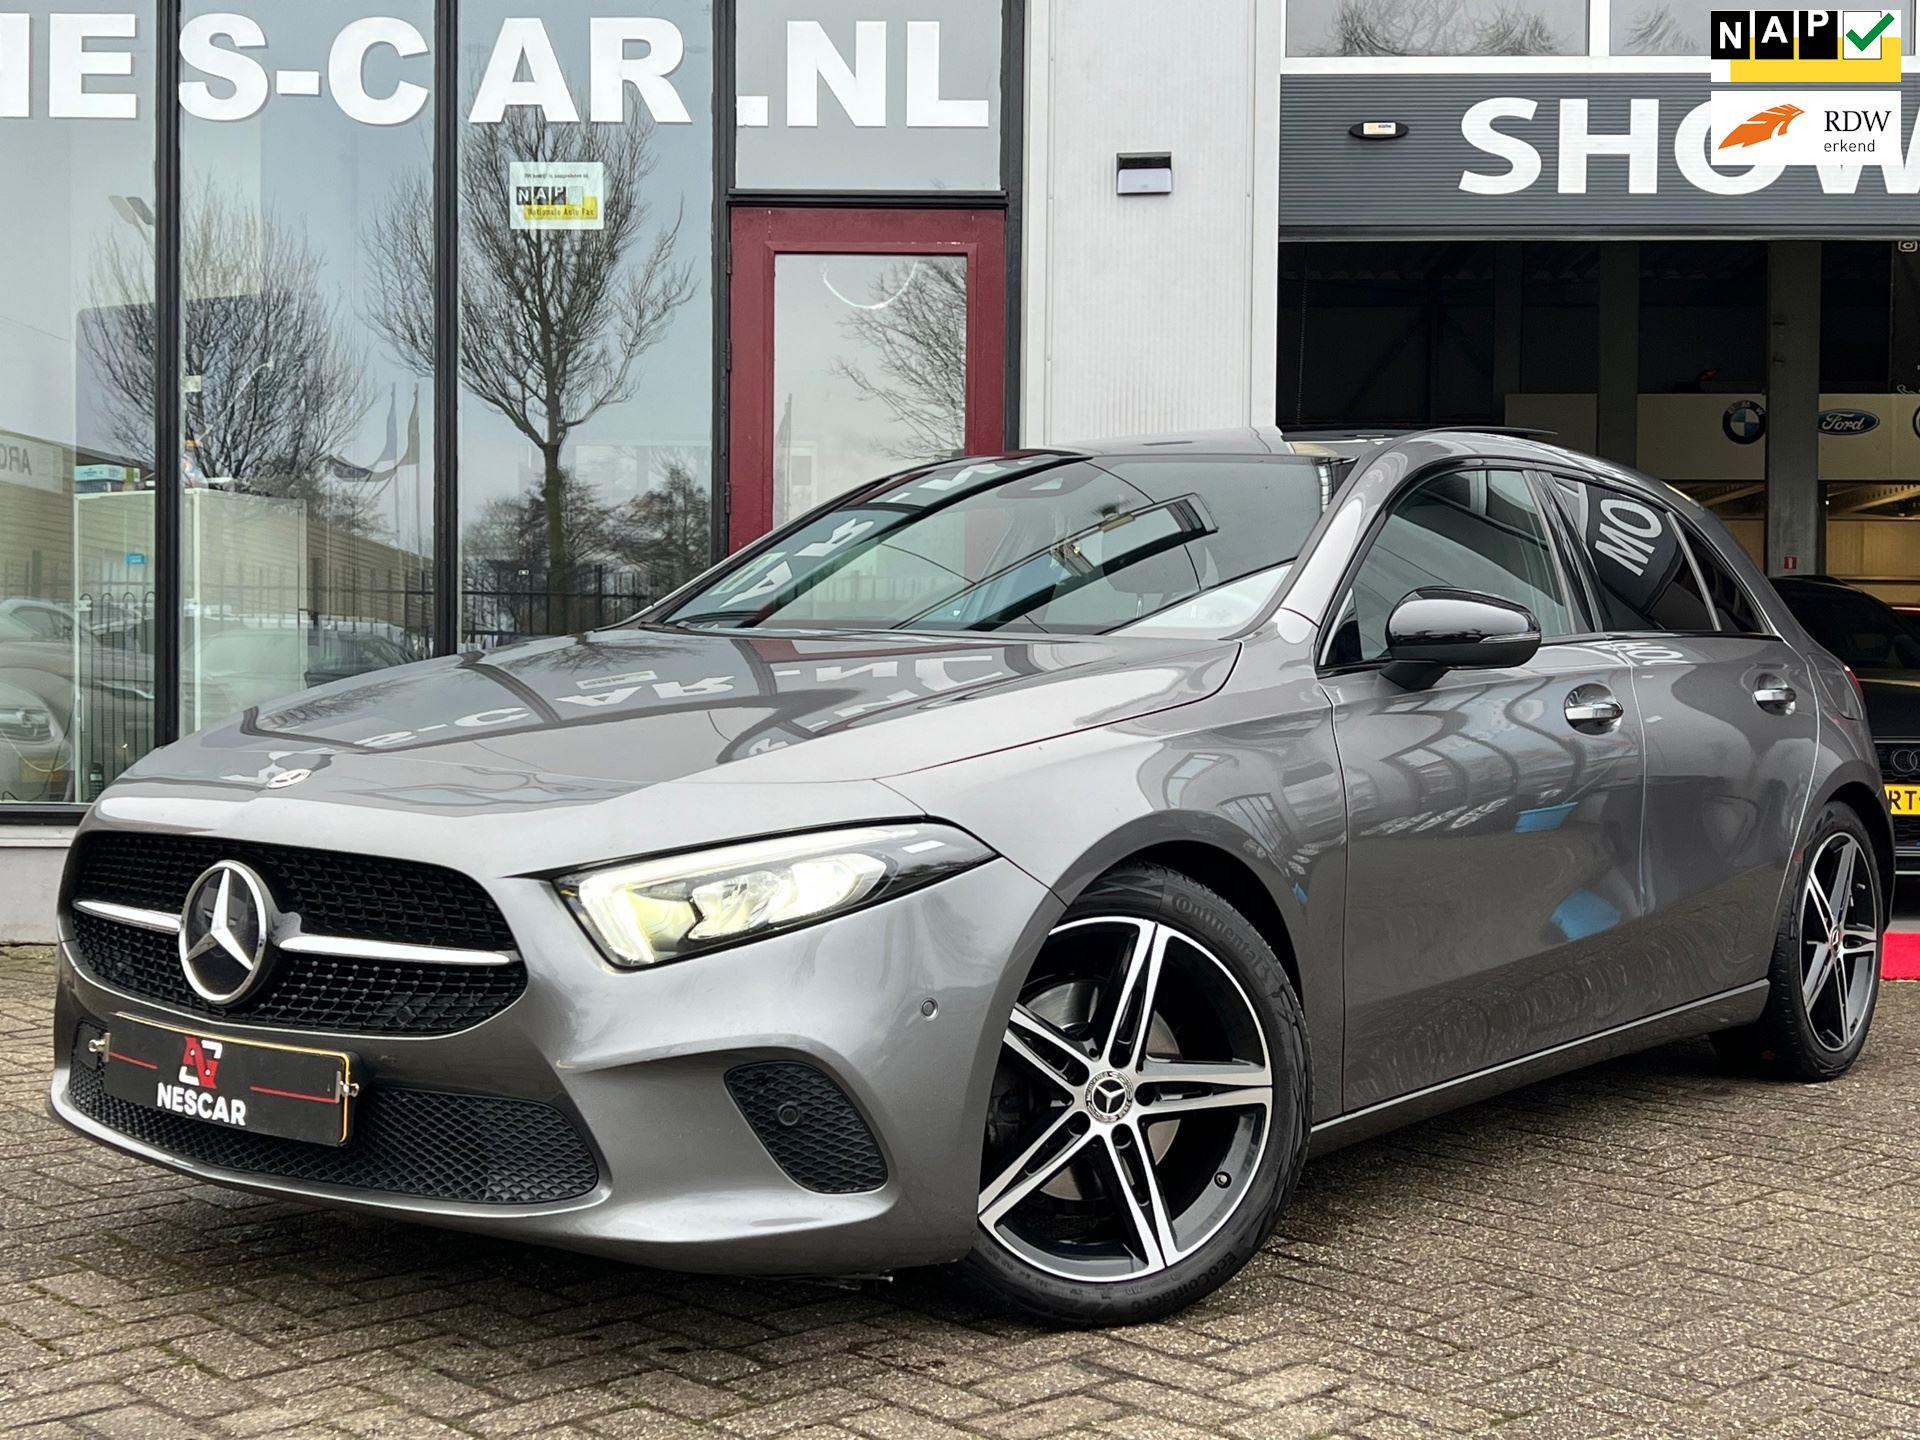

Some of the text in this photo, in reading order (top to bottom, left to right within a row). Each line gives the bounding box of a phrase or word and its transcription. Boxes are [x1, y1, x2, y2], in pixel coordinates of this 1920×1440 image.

[518, 187, 564, 203] NAP
[1821, 413, 1866, 431] Ford
[157, 1082, 247, 1126] NESCAR
